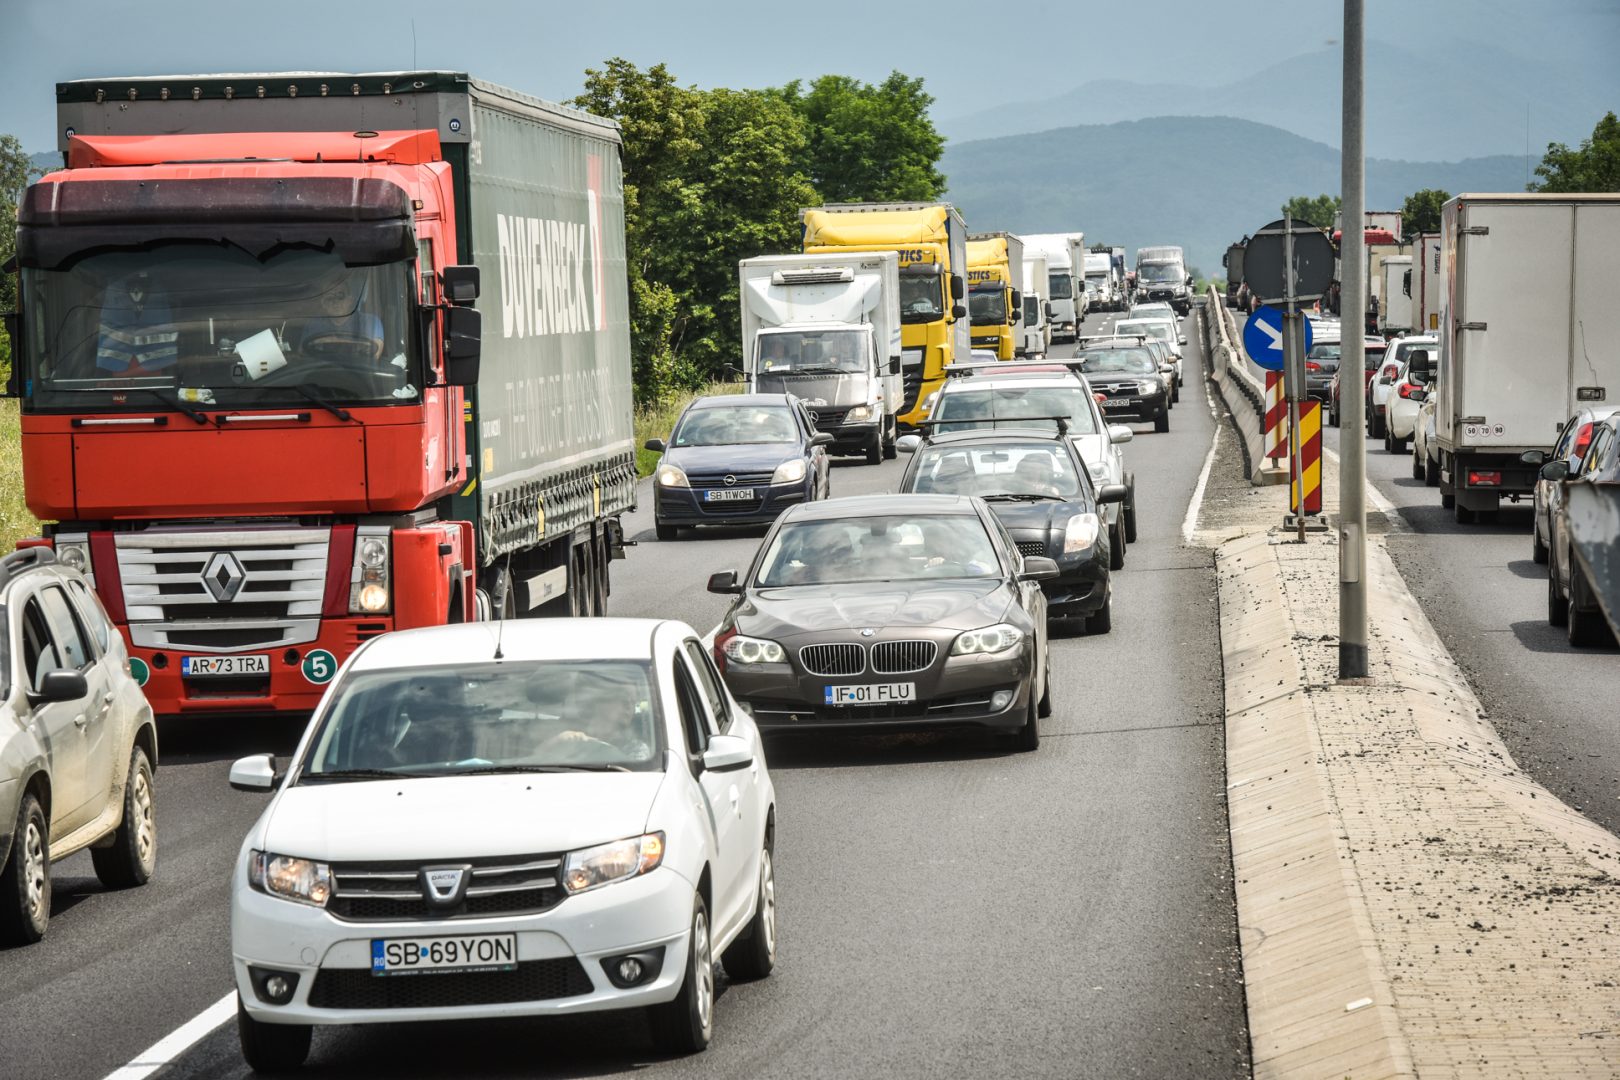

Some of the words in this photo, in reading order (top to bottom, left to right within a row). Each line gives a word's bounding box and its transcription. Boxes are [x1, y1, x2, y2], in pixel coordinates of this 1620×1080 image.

[897, 249, 922, 262] TICS
[497, 213, 590, 339] DUVENBECK
[710, 491, 721, 500] SB
[725, 490, 751, 499] 11WOH
[192, 659, 210, 673] AR
[215, 658, 233, 672] 73
[237, 657, 265, 672] TRA
[312, 656, 328, 678] 5
[836, 687, 850, 701] IF
[856, 686, 870, 700] 01
[878, 684, 909, 699] FLU
[386, 942, 420, 966] SB
[430, 938, 512, 964] 69YON
[373, 957, 385, 967] RO
